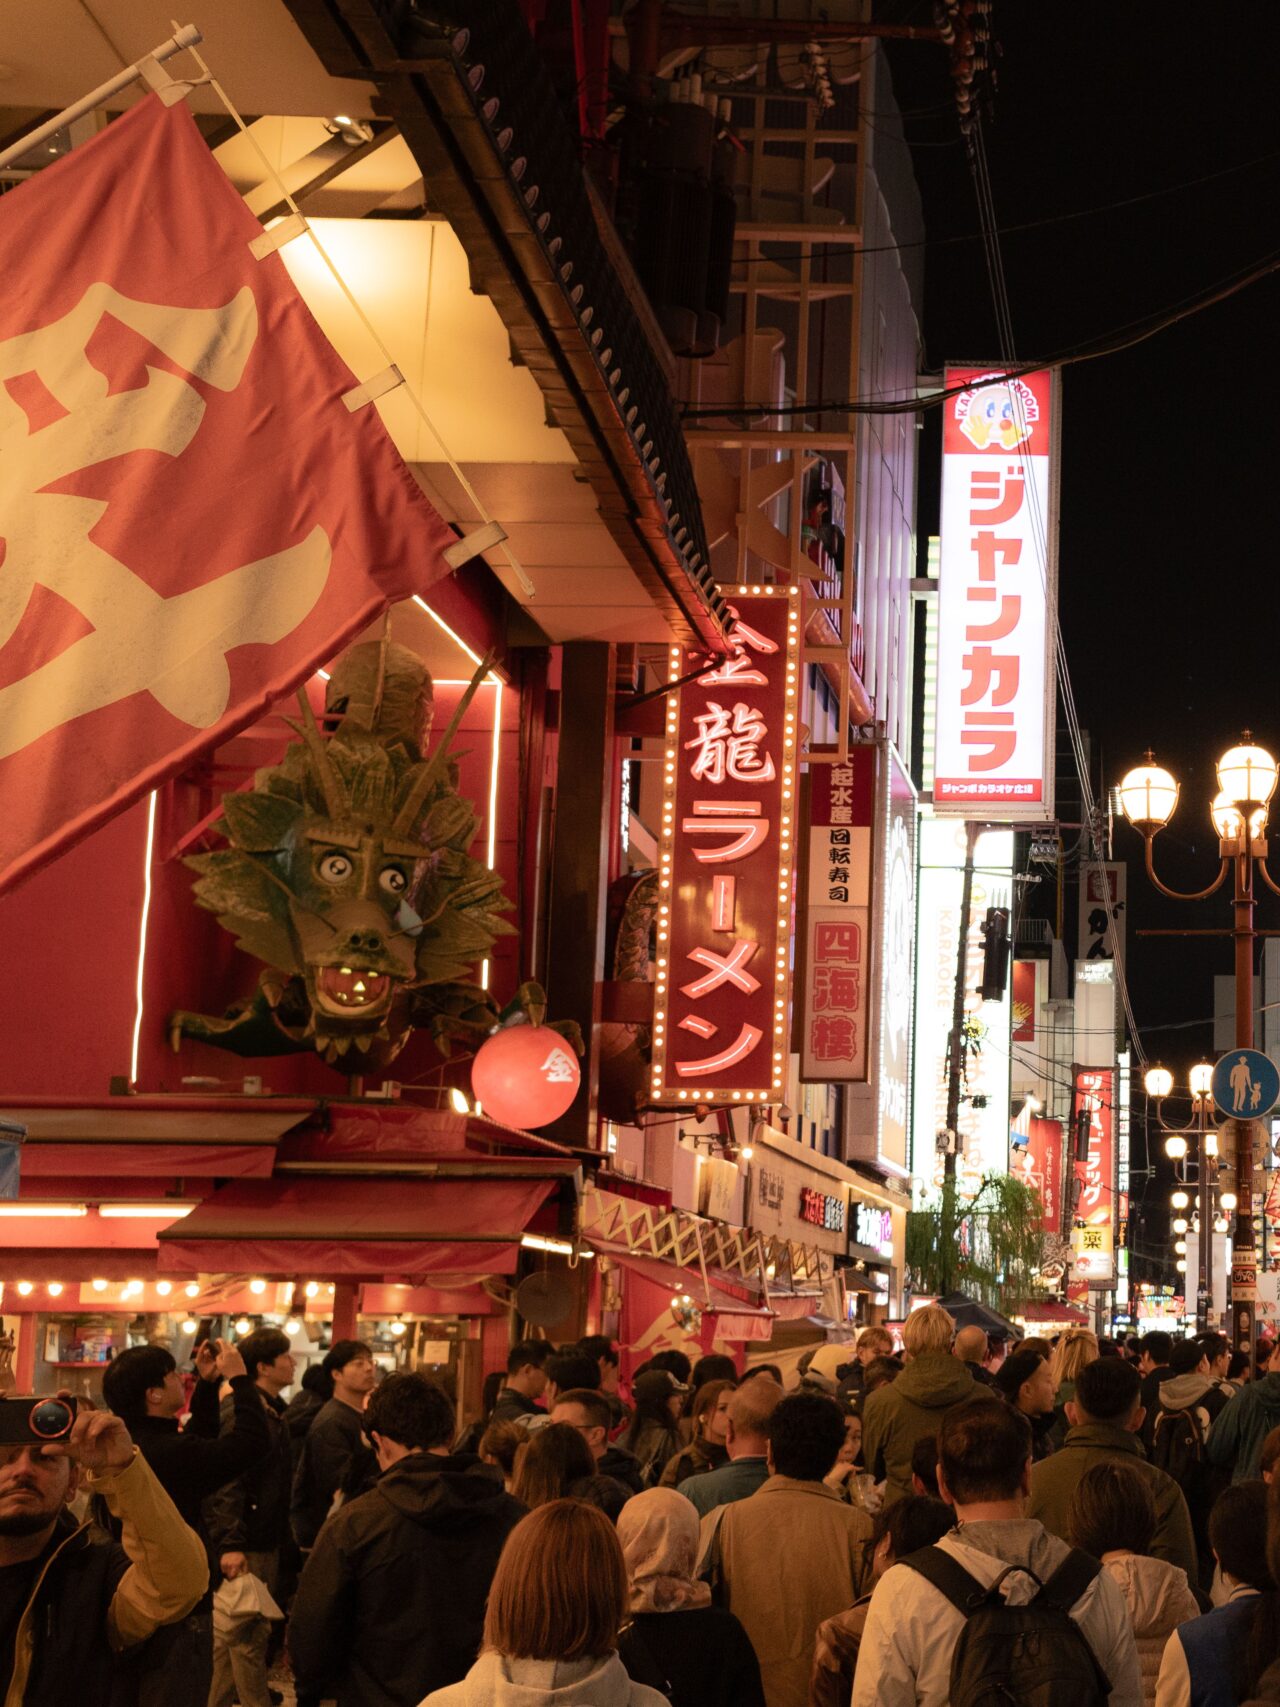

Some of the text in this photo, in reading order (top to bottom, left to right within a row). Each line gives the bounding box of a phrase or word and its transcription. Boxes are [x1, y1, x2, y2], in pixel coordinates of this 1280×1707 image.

[960, 466, 1025, 772] ジャンカラ
[675, 606, 779, 1078] 金龍ラーメン
[829, 829, 851, 903] 回転寿司
[937, 909, 952, 1008] KARAOKE
[540, 1046, 577, 1083] 金
